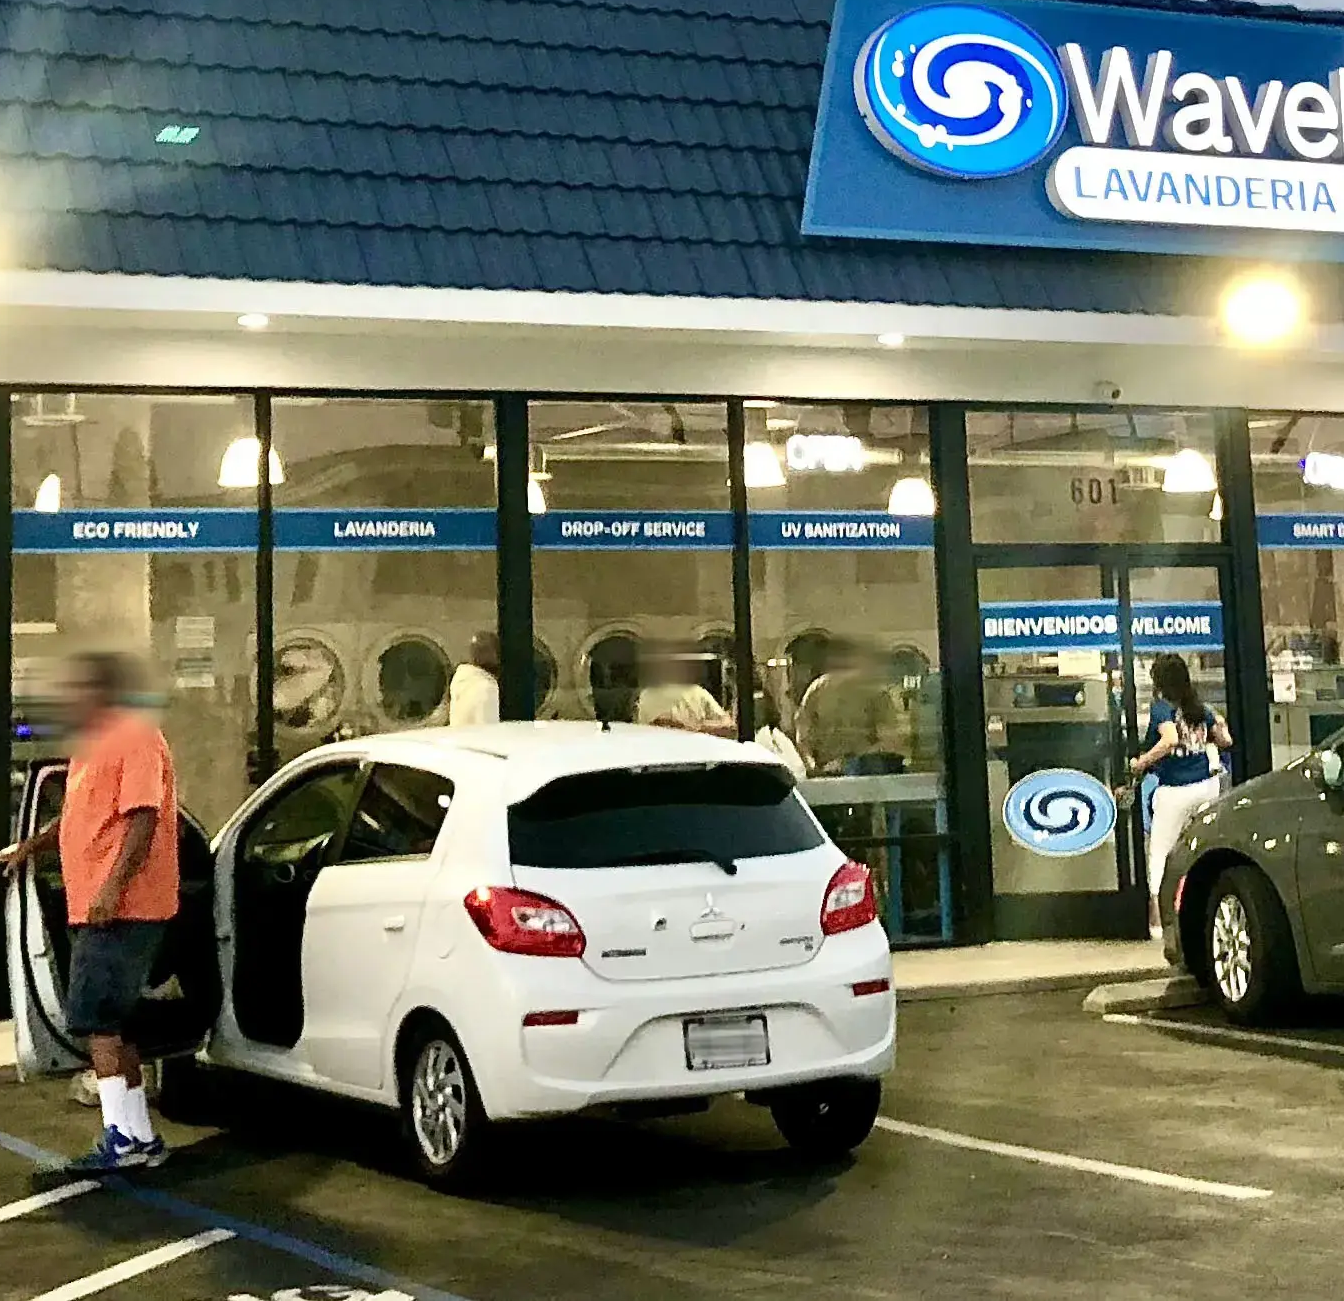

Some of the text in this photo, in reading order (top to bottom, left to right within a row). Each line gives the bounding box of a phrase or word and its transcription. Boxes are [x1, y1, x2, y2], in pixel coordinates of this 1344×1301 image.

[1073, 166, 1337, 214] LAVANDERIA
[1070, 477, 1117, 505] 601
[72, 521, 200, 539] ECO FRIENDLY
[333, 520, 436, 538] LAVANDERIA
[561, 520, 706, 538] DROP-OFF SERVICE
[781, 521, 901, 539] UV SANITIZATION
[1293, 522, 1335, 539] SMART
[984, 614, 1212, 637] BIENVENIDOS WELCOME
